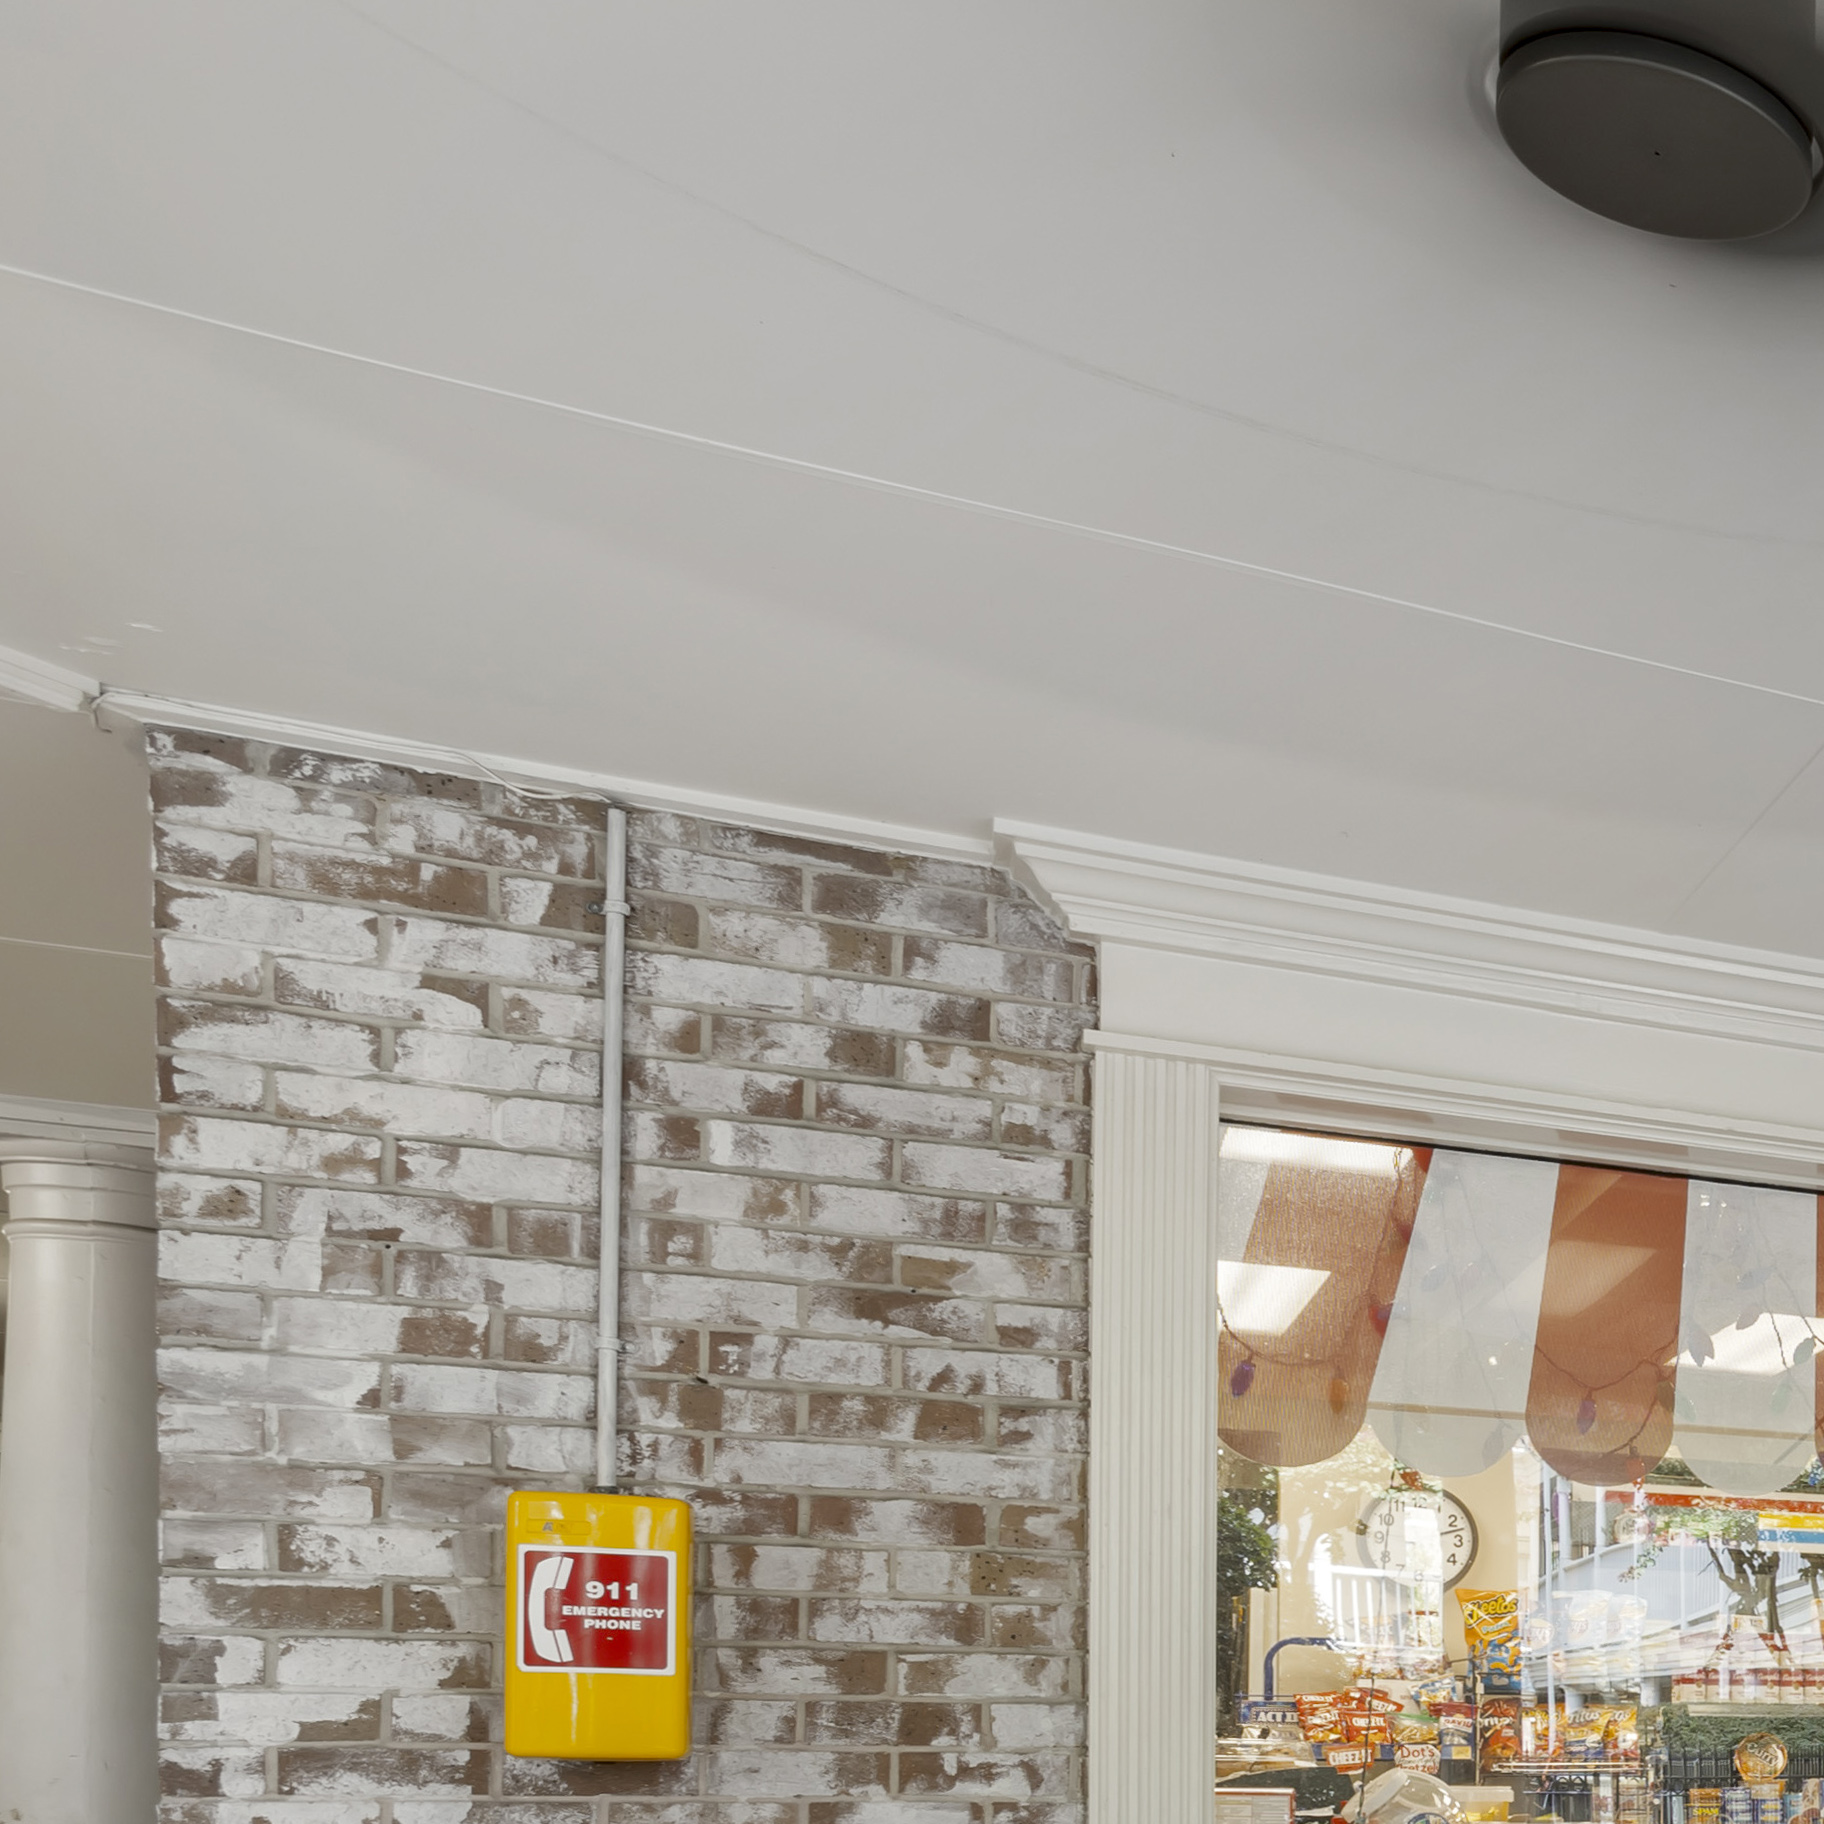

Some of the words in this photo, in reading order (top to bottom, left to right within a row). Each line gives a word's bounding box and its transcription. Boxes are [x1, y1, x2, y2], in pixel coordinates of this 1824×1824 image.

[1448, 1514, 1458, 1527] 2
[1374, 1531, 1385, 1544] 9
[1453, 1534, 1463, 1548] 3
[1446, 1553, 1457, 1566] 4
[585, 1581, 639, 1600] 911
[562, 1605, 665, 1618] EMERGENCY
[584, 1619, 641, 1630] PHONE
[1257, 1711, 1282, 1723] ACT
[1400, 1745, 1436, 1759] Dot's
[1692, 1808, 1720, 1816] SPAM
